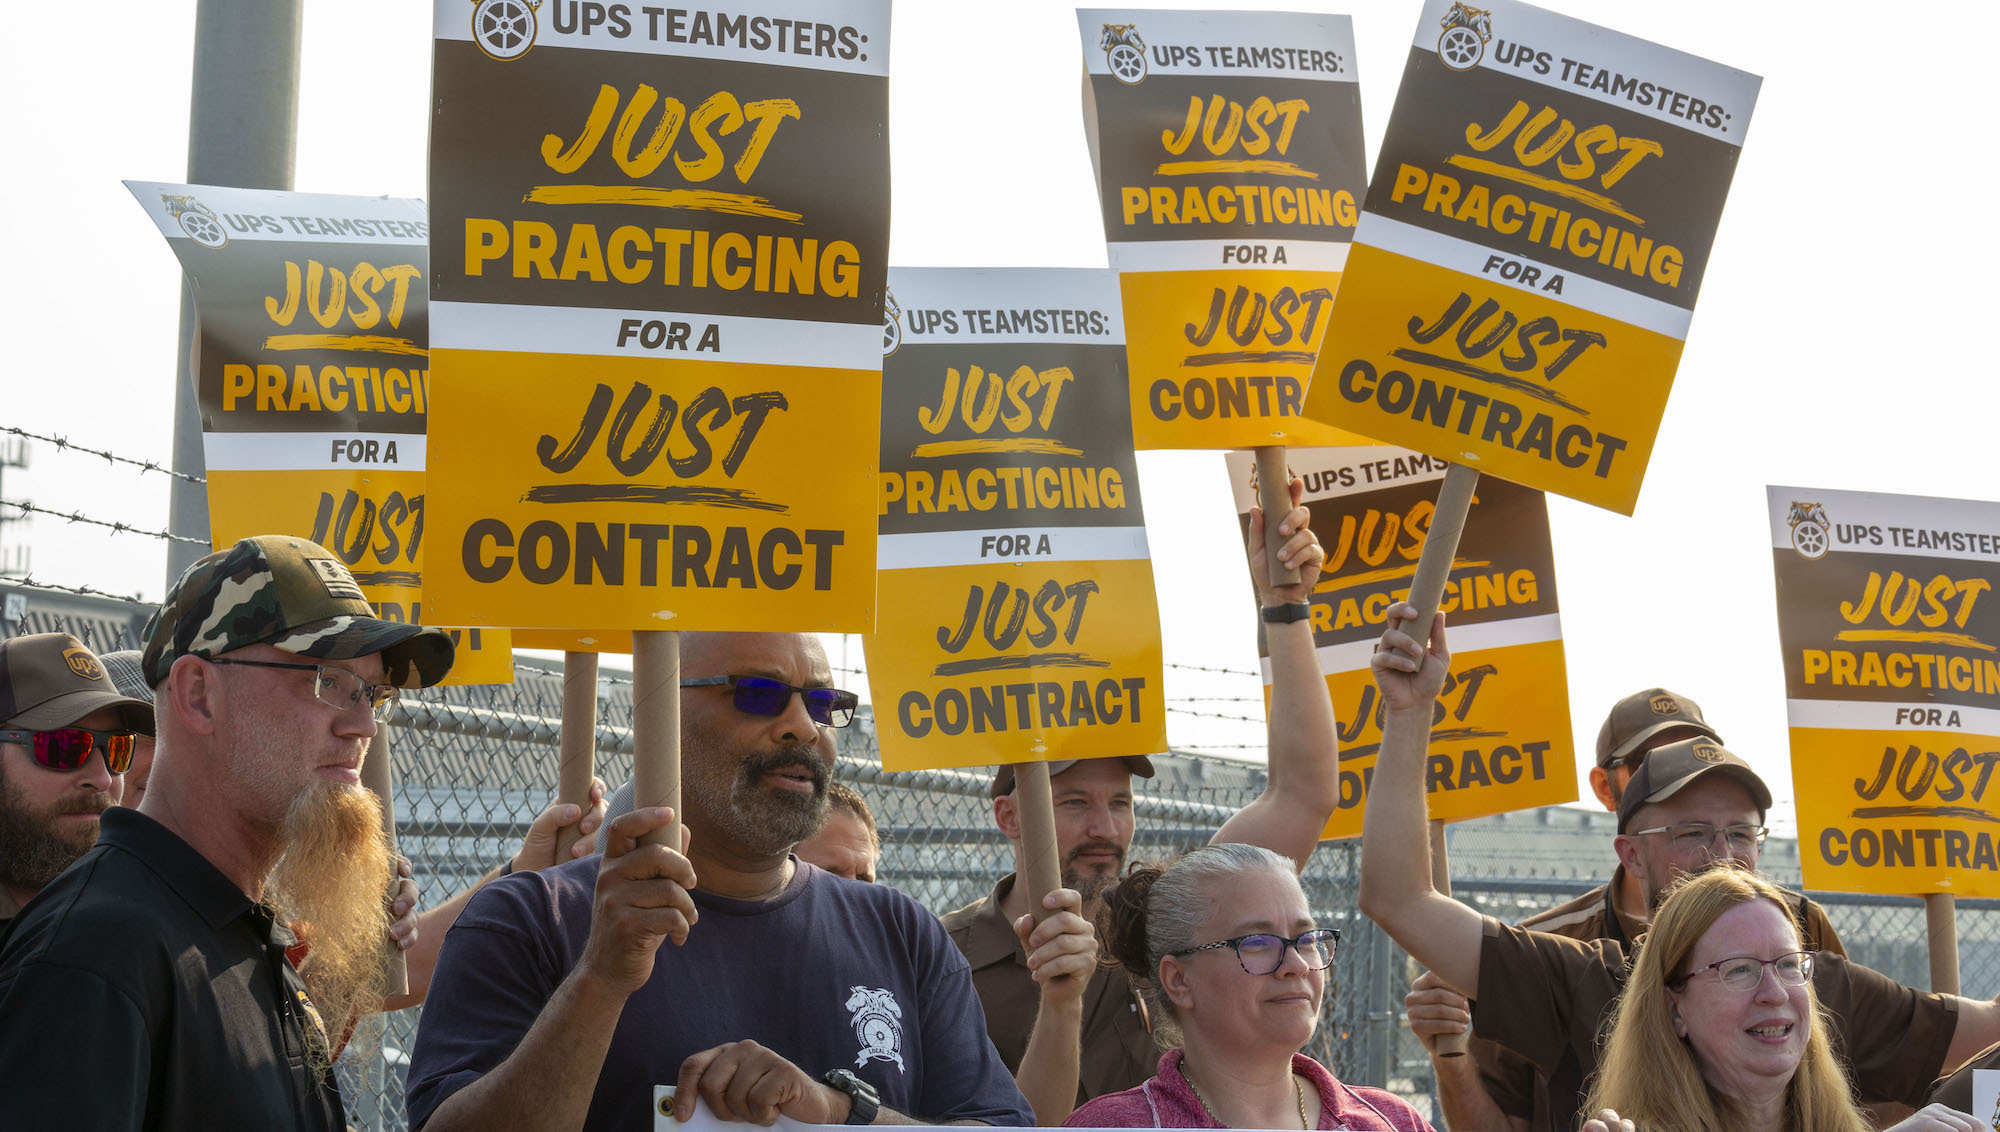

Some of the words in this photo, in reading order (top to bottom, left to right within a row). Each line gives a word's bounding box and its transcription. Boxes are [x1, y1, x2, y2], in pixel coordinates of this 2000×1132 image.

[552, 0, 632, 38] UPS
[643, 6, 868, 62] TEAMSTERS:
[1152, 46, 1201, 67] UPS
[1206, 47, 1344, 73] TEAMSTERS:
[1494, 40, 1552, 75] UPS
[1560, 58, 1732, 133] TEAMSTERS:
[541, 83, 801, 184] JUST
[1161, 94, 1310, 156] JUST
[1465, 100, 1664, 190] JUST
[223, 213, 284, 234] UPS
[1121, 186, 1358, 227] PRACTICING
[1390, 163, 1685, 289] PRACTICING
[464, 218, 861, 298] PRACTICING
[1222, 245, 1268, 265] FOR
[1273, 245, 1288, 265] A
[1482, 255, 1541, 287] FOR
[1544, 274, 1566, 295] A
[265, 260, 421, 330] JUST
[1184, 285, 1334, 348] JUST
[616, 319, 692, 351] FOR
[697, 324, 720, 352] A
[907, 309, 959, 334] UPS
[962, 310, 1110, 336] TEAMSTERS:
[1407, 292, 1607, 381] JUST
[223, 364, 428, 414] PRACTICI
[917, 364, 1074, 435] JUST
[1149, 374, 1302, 422] CONTR
[536, 381, 788, 478] JUST
[1338, 359, 1628, 479] CONTRACT
[331, 439, 379, 463] FOR
[384, 440, 399, 463] A
[878, 467, 1126, 515] PRACTICING
[1303, 467, 1355, 493] UPS
[461, 518, 844, 590] CONTRACT
[980, 535, 1030, 558] FOR
[1035, 534, 1051, 556] A
[1322, 495, 1480, 573] JUS
[1836, 524, 1883, 545] UPS
[937, 580, 1099, 654] JUST
[1840, 571, 1991, 628] JUST
[69, 657, 99, 674] ups
[898, 678, 1145, 738] CONTRACT
[1653, 700, 1677, 713] ups
[1896, 708, 1942, 726] FOR
[1947, 709, 1961, 727] A
[1696, 749, 1722, 761] ups
[1820, 828, 2000, 871] CONTRA
